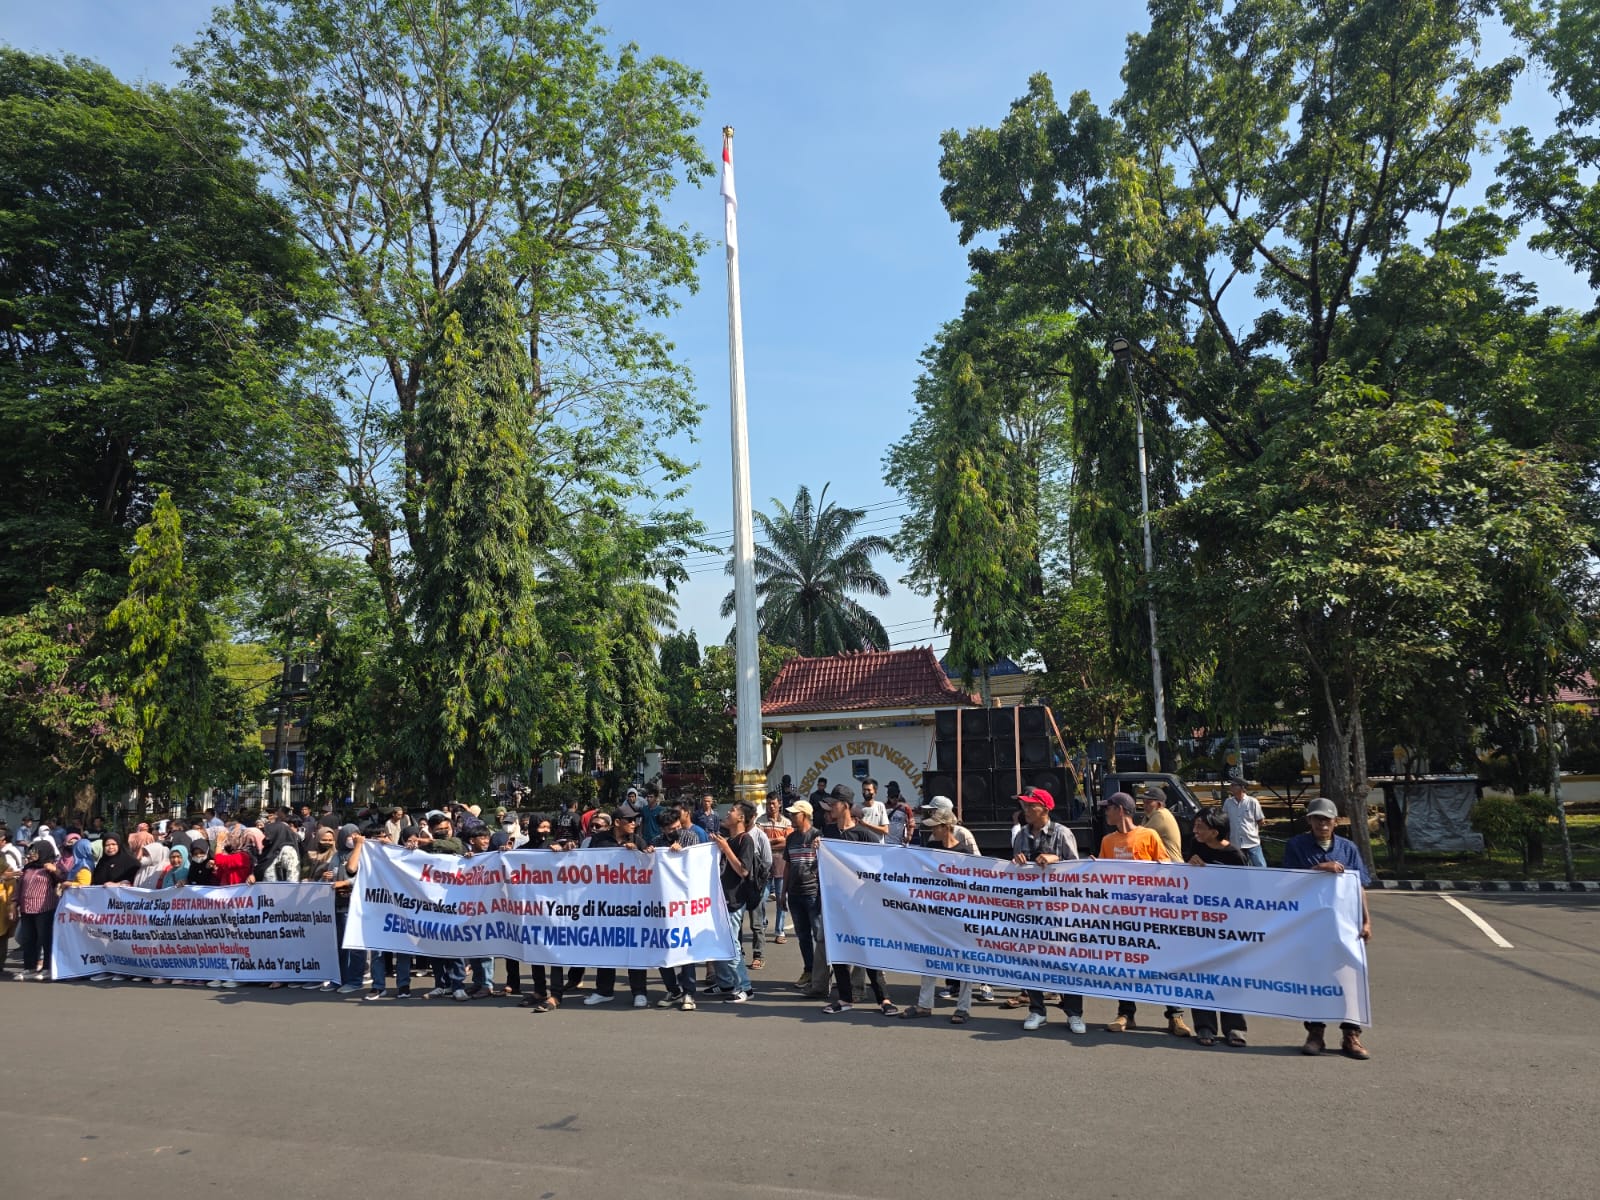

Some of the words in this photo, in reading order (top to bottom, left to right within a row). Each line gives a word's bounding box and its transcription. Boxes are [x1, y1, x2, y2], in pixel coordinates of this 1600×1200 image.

[798, 744, 844, 797] SEGANTI
[420, 864, 500, 886] Kembalikan
[502, 864, 552, 884] Lahan
[556, 865, 592, 884] 400
[596, 863, 653, 884] Hektar
[938, 864, 971, 876] Cabut
[973, 868, 997, 879] HGU
[999, 872, 1014, 880] PT
[1017, 873, 1040, 882] BSP
[1049, 873, 1080, 883] BUMI
[1082, 874, 1125, 885] SAWIT
[1128, 876, 1180, 888] PERMAI
[1184, 877, 1188, 890] )
[107, 898, 153, 913] Masyarakat
[154, 899, 170, 913] Siap
[258, 895, 274, 910] Jika
[365, 888, 393, 904] Milik
[394, 892, 458, 914] Masyarakat
[458, 901, 488, 916] DESA
[491, 898, 542, 916] ARAHAN
[546, 901, 580, 920] Yang
[583, 900, 594, 916] di
[598, 900, 641, 916] Kuasai
[644, 904, 666, 917] oleh
[669, 901, 688, 917] PT
[691, 897, 711, 916] BSP
[856, 871, 881, 882] yang
[884, 872, 910, 883] telah
[912, 877, 966, 890] menzolimi
[970, 881, 990, 892] dan
[992, 885, 1057, 897] mengambil
[1060, 887, 1083, 898] hak
[1086, 888, 1109, 899] hak
[1112, 892, 1188, 904] masyarakat
[1194, 895, 1230, 908] DESA
[1234, 898, 1298, 911] ARAHAN
[126, 914, 148, 925] RAYA
[149, 914, 172, 926] Masih
[173, 914, 219, 926] Melakukan
[220, 913, 260, 927] Kegiatan
[262, 910, 312, 924] Pembuatan
[312, 911, 333, 926] Jalan
[909, 889, 965, 902] TANGKAP
[968, 894, 1024, 909] MANEGER
[1027, 901, 1042, 911] PT
[1046, 902, 1069, 912] BSP
[1072, 903, 1100, 914] DAN
[1102, 905, 1147, 916] CABUT
[1150, 908, 1178, 919] HGU
[1181, 909, 1198, 920] PT
[1202, 911, 1228, 923] BSP
[113, 929, 131, 940] Batu
[132, 930, 150, 940] Bara
[151, 930, 176, 940] Diatas
[178, 929, 204, 940] Lahan
[204, 929, 225, 939] HGU
[226, 928, 278, 940] Perkebunan
[280, 926, 305, 939] Sawit
[384, 913, 439, 941] SEBELUM
[440, 921, 541, 945] MASYARAKAT
[544, 926, 637, 948] MENGAMBIL
[641, 927, 692, 949] PAKSA
[882, 898, 926, 913] DENGAN
[928, 905, 989, 920] MENGALIH
[991, 911, 1062, 925] PUNGSIKAN
[1065, 917, 1110, 930] LAHAN
[1113, 920, 1141, 932] HGU
[1143, 923, 1216, 939] PERKEBUN
[1218, 929, 1265, 942] SAWIT
[964, 923, 980, 933] KE
[981, 925, 1018, 938] JALAN
[1021, 929, 1077, 943] HAULING
[1080, 934, 1115, 945] BATU
[1118, 936, 1160, 950] BARA.
[80, 954, 106, 966] Yang
[152, 957, 196, 969] GUBERNUR
[199, 957, 229, 970] SUMSEL
[230, 958, 256, 970] Tidak
[258, 959, 276, 970] Ada
[278, 958, 301, 973] Yang
[302, 958, 320, 970] Lain
[132, 944, 157, 958] Hanya
[160, 944, 175, 954] Ada
[177, 944, 196, 954] Satu
[196, 944, 218, 956] Jalan
[220, 943, 251, 958] Hauling
[976, 938, 1036, 953] TANGKAP
[1038, 945, 1066, 956] DAN
[1069, 948, 1102, 960] ADILI
[1105, 950, 1122, 961] PT
[1125, 952, 1149, 964] BSP
[836, 933, 865, 946] YANG
[867, 937, 903, 950] TELAH
[904, 942, 960, 958] MEMBUAT
[962, 949, 1039, 968] KEGADUHAN
[1041, 959, 1136, 978] MASYARAKAT
[1139, 969, 1241, 988] MENGALIHKAN
[1244, 978, 1307, 995] FUNGSIH
[1310, 985, 1343, 997] HGU
[926, 959, 954, 971] DEMI
[956, 963, 971, 974] KE
[973, 966, 1040, 983] UNTUNGAN
[1042, 974, 1132, 992] PERUSAHAAN
[1135, 982, 1172, 996] BATU
[1175, 986, 1215, 1000] BARA
